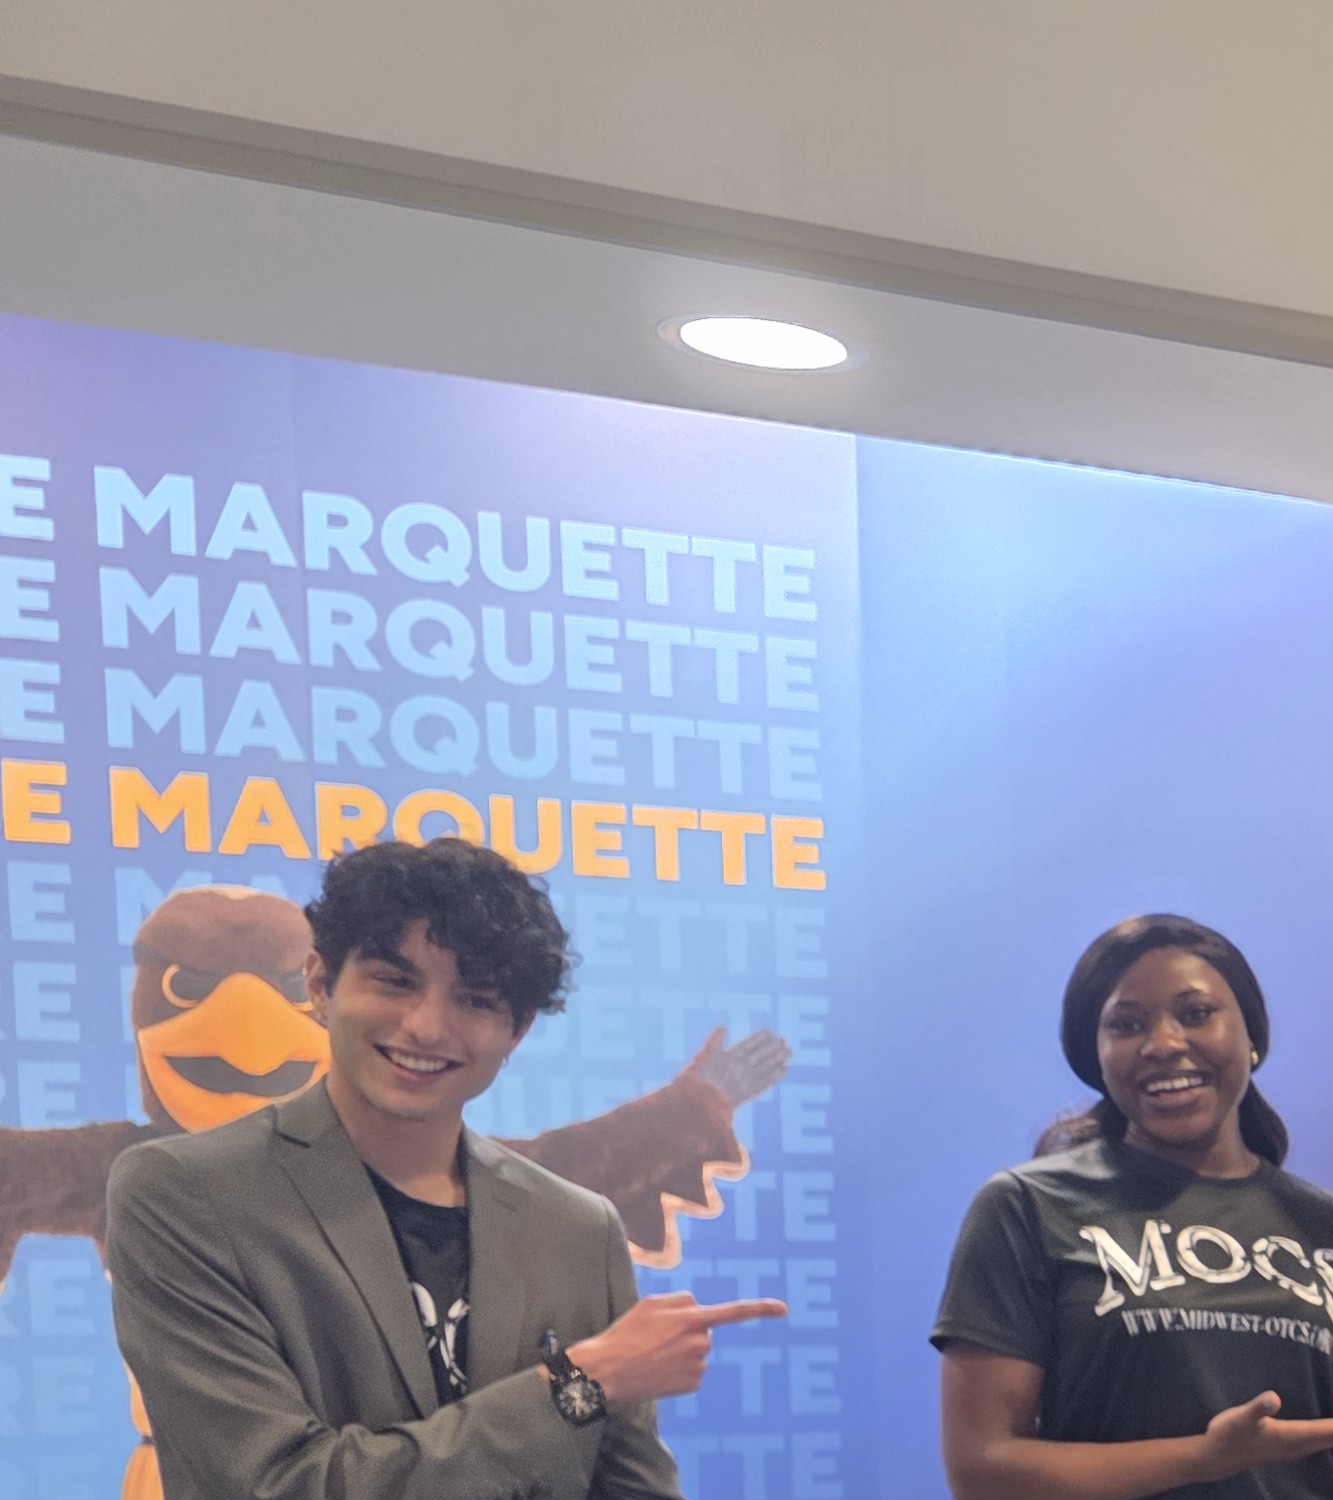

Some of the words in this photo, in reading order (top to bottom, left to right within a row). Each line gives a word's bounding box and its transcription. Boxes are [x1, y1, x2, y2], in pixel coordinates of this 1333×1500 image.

[94, 464, 818, 622] MARQUETTE
[98, 566, 820, 712] MARQUETTE
[105, 667, 823, 800] MARQUETTE
[109, 765, 827, 891] MARQUETTE
